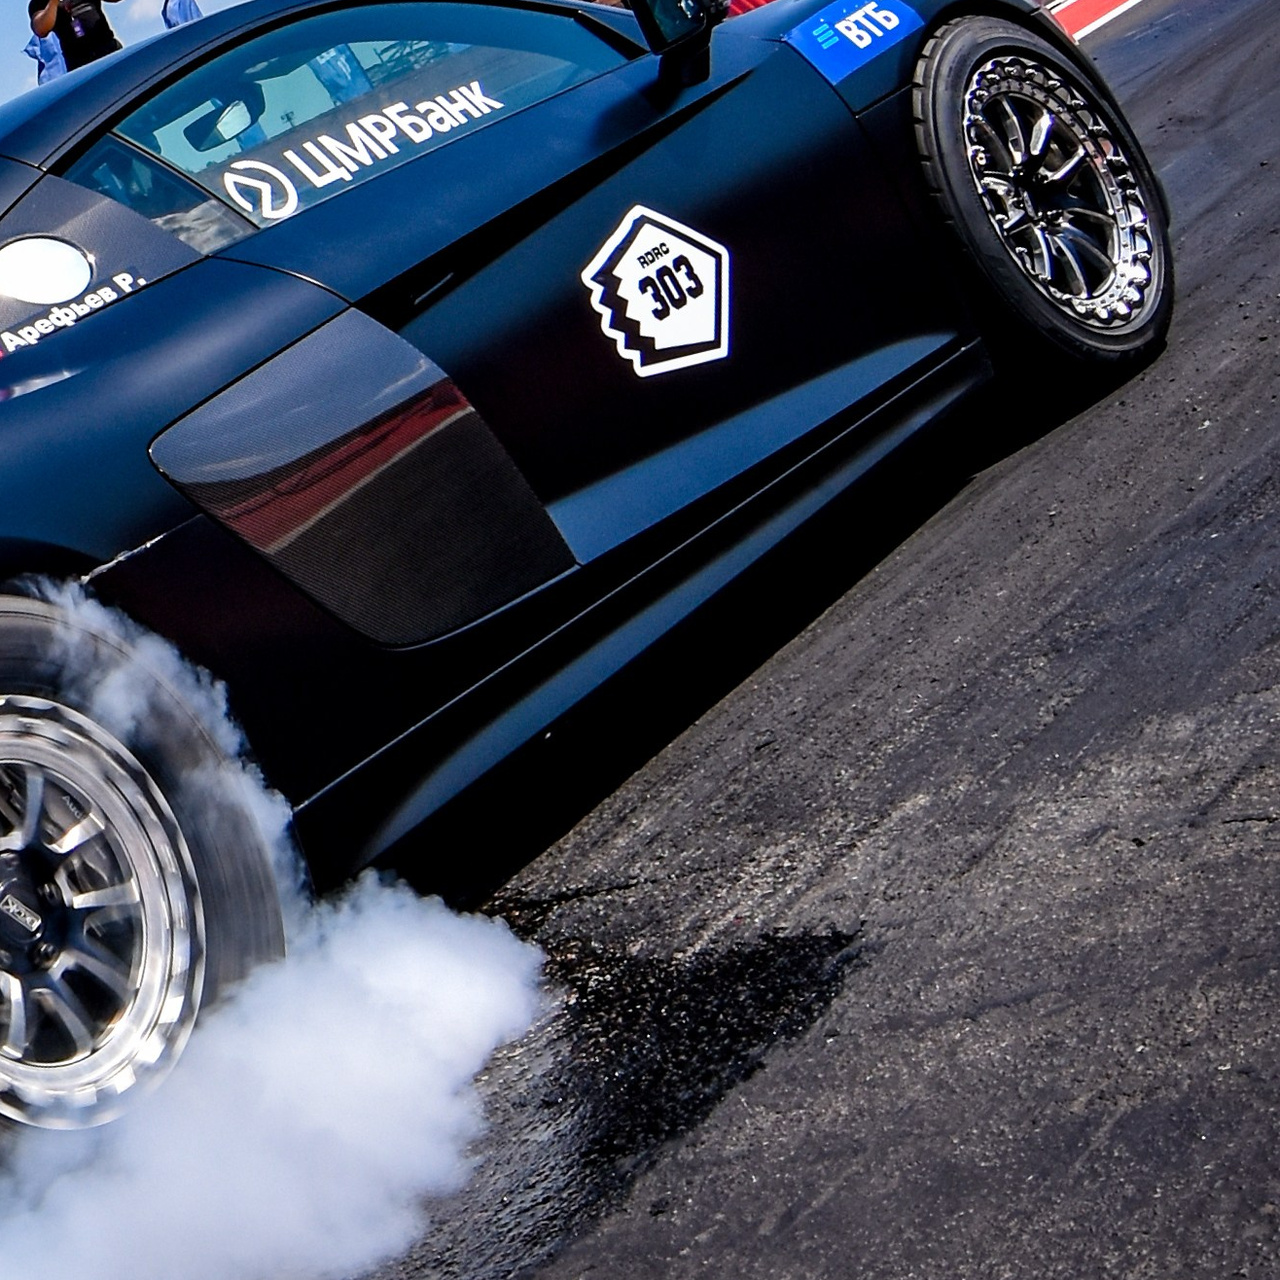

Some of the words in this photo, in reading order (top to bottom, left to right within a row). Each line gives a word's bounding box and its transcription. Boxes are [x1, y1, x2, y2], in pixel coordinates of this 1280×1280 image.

[834, 1, 900, 49] ВТБ
[282, 80, 506, 189] ЦМРБанк
[636, 242, 671, 269] RDRC
[638, 254, 704, 322] 303
[0, 285, 118, 353] Арефьев
[112, 271, 148, 294] Р.
